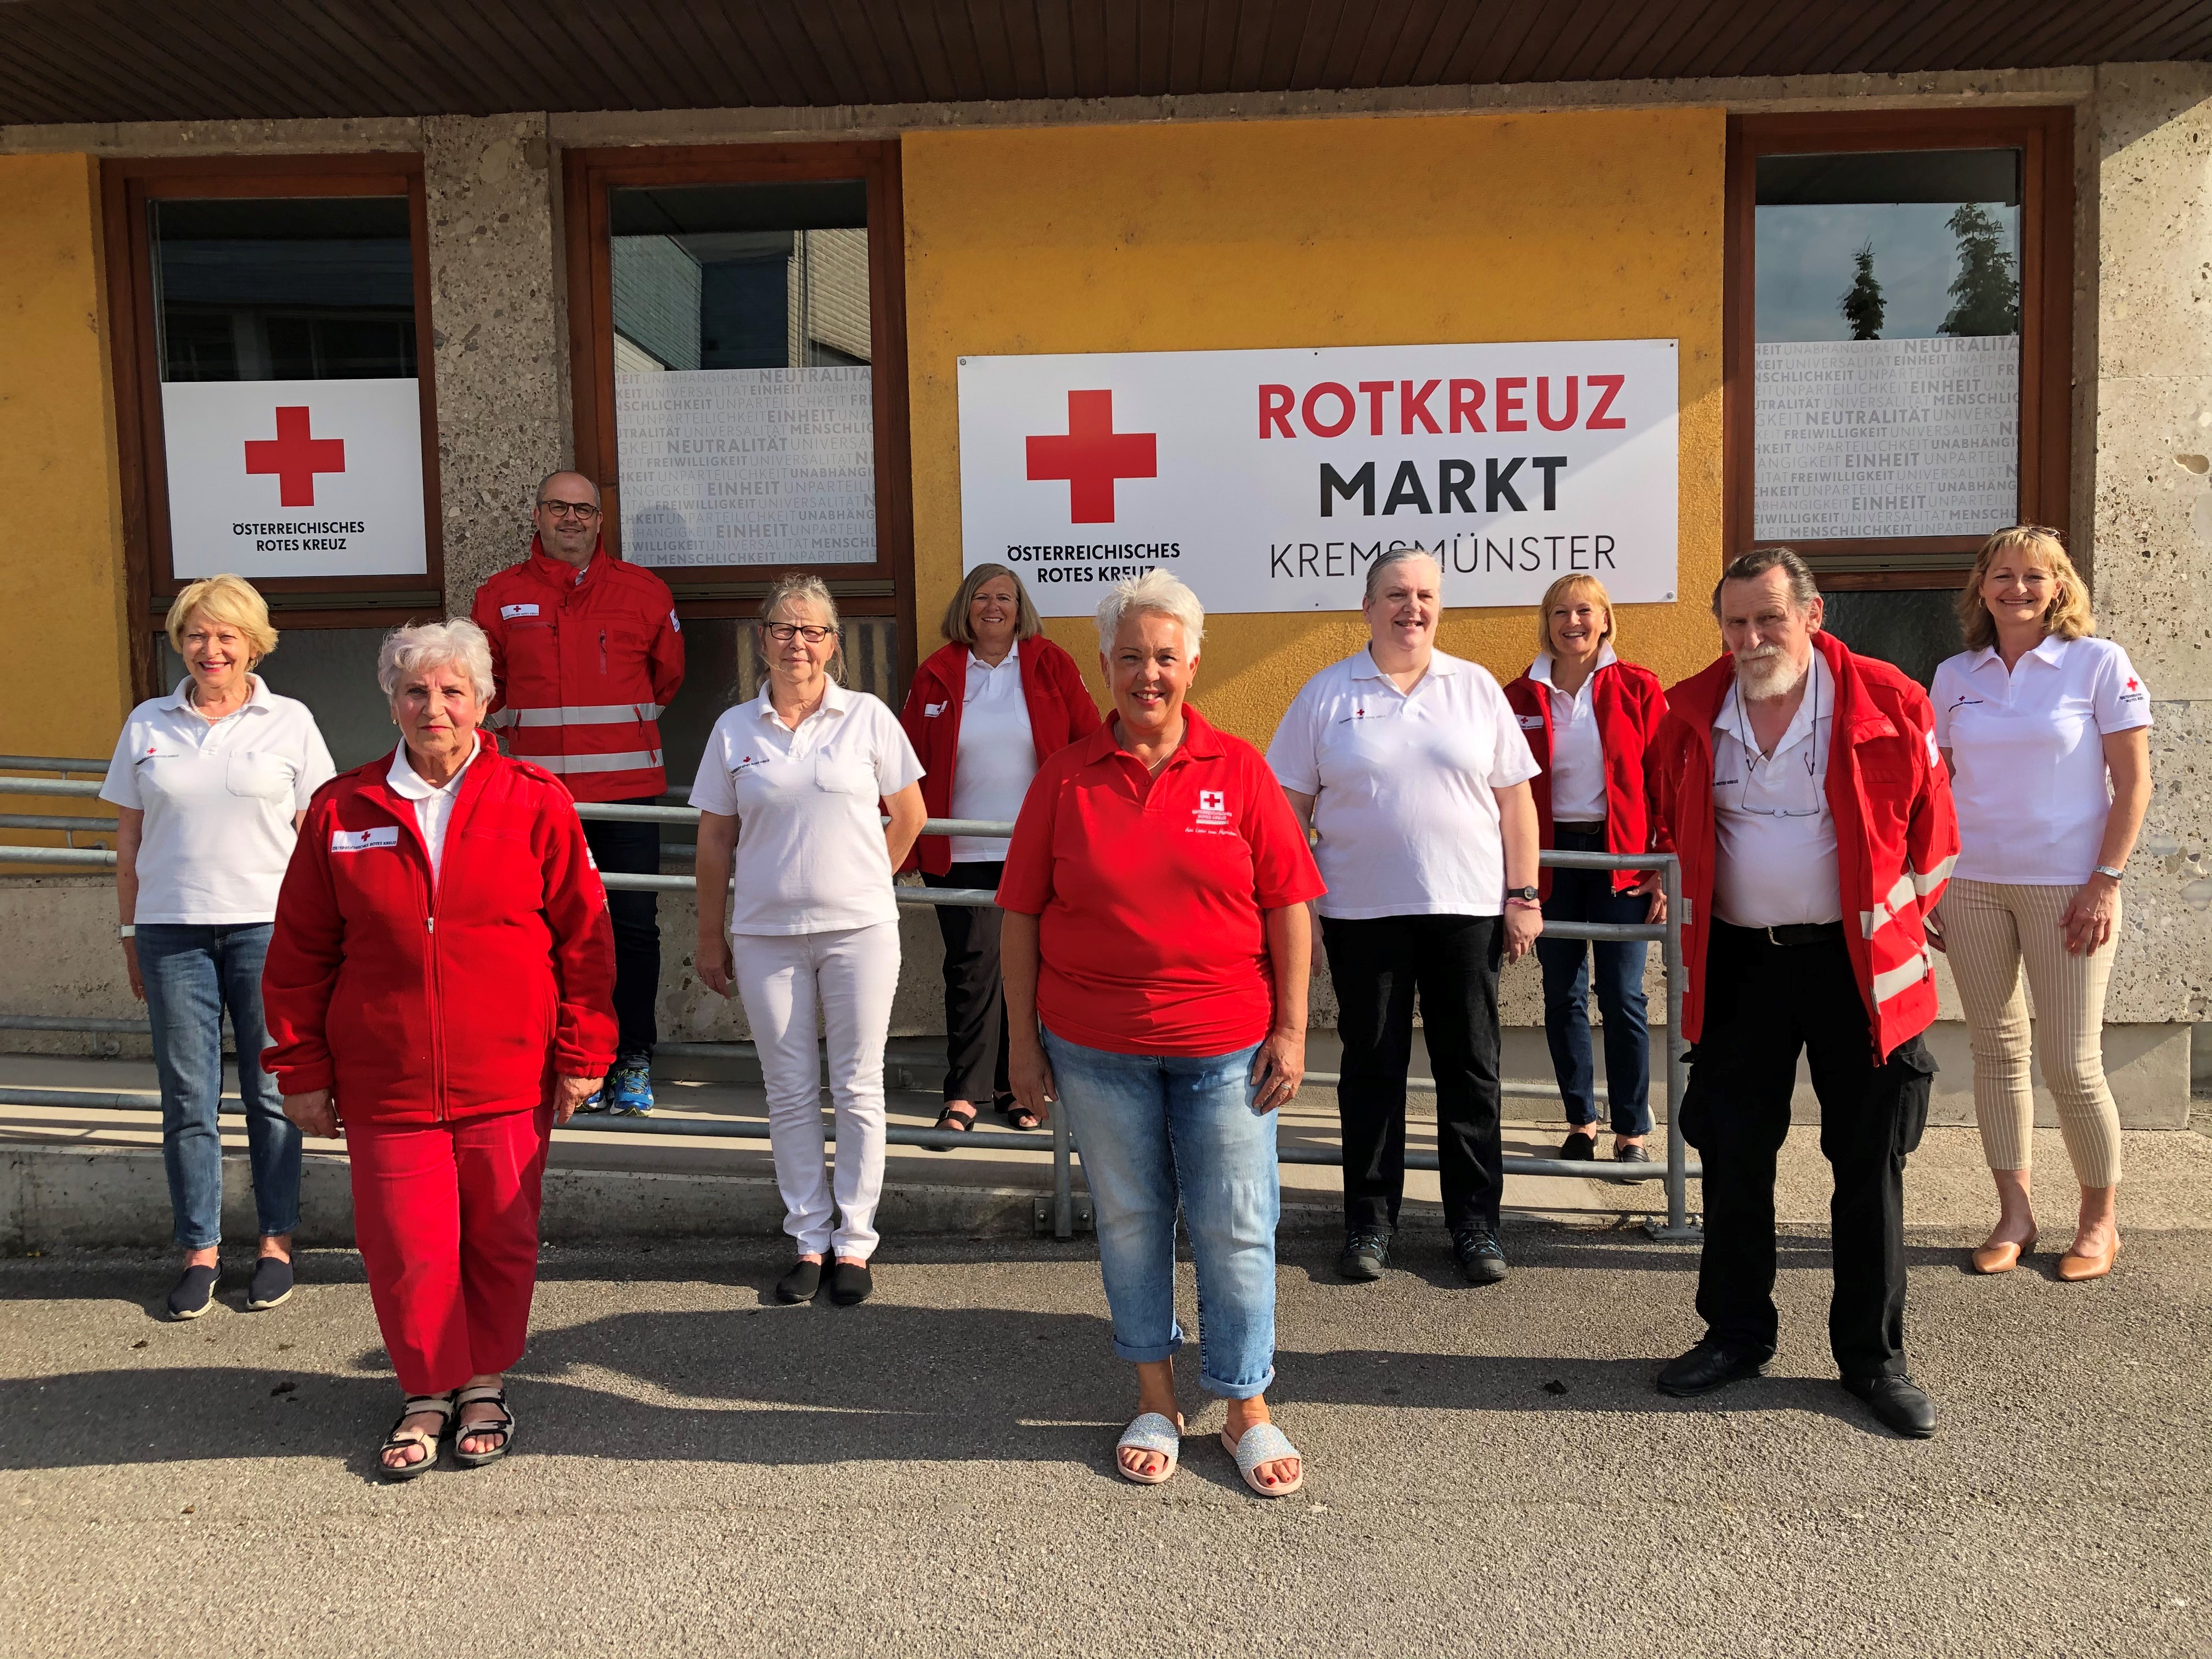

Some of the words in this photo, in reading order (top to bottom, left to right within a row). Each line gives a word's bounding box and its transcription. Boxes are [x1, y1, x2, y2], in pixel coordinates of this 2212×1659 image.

[1894, 354, 1948, 366] EINHEIT
[1859, 365, 1993, 381] UNPARTEILICHKEIT
[1997, 364, 2018, 376] FR
[750, 384, 802, 395] EINHEIT
[1776, 382, 1909, 397] UNPARTEILICHKEIT
[1911, 379, 1981, 394] EINHEIT
[716, 395, 846, 409] UNPARTEILICHKEIT
[1259, 374, 1627, 439] ROTKREUZ
[636, 410, 766, 425] UNPARTEILICHKEIT
[768, 409, 836, 423] EINHEIT
[1755, 412, 1802, 426] GKEIT
[1806, 406, 1931, 425] NEUTRALITÄT
[1784, 427, 1887, 439] FREIWILLIGKEIT
[618, 441, 663, 455] GKEIT
[667, 435, 788, 454] NEUTRALITÄT
[1796, 439, 1928, 453] UNPARTEILICHKEIT
[647, 455, 747, 467] FREIWILLIGKEIT
[1845, 452, 1920, 468] EINHEIT
[658, 467, 787, 482] UNPARTEILICHKEIT
[1791, 470, 1894, 483] FREIWILLIGKEIT
[707, 481, 780, 496] EINHEIT
[1319, 456, 1568, 517] MARKT
[1802, 482, 1935, 496] UNPARTEILICHKEIT
[656, 499, 756, 510] FREIWILLIGKEIT
[1852, 495, 1926, 511] EINHEIT
[667, 510, 795, 524] UNPARTEILICHKEIT
[1949, 509, 2017, 520] MENSCHL
[233, 521, 365, 536] ÖSTERREICHISCHES
[716, 523, 788, 538] EINHEIT
[1790, 524, 1912, 537] MENSCHLICHKEIT
[256, 539, 300, 552] ROTES
[303, 538, 347, 551] KREUZ
[811, 537, 877, 549] MENSCHL
[657, 552, 776, 565] MENSCHLICHKEIT
[1007, 543, 1180, 562] ÖSTERREICHISCHES
[1037, 567, 1093, 583] ROTES
